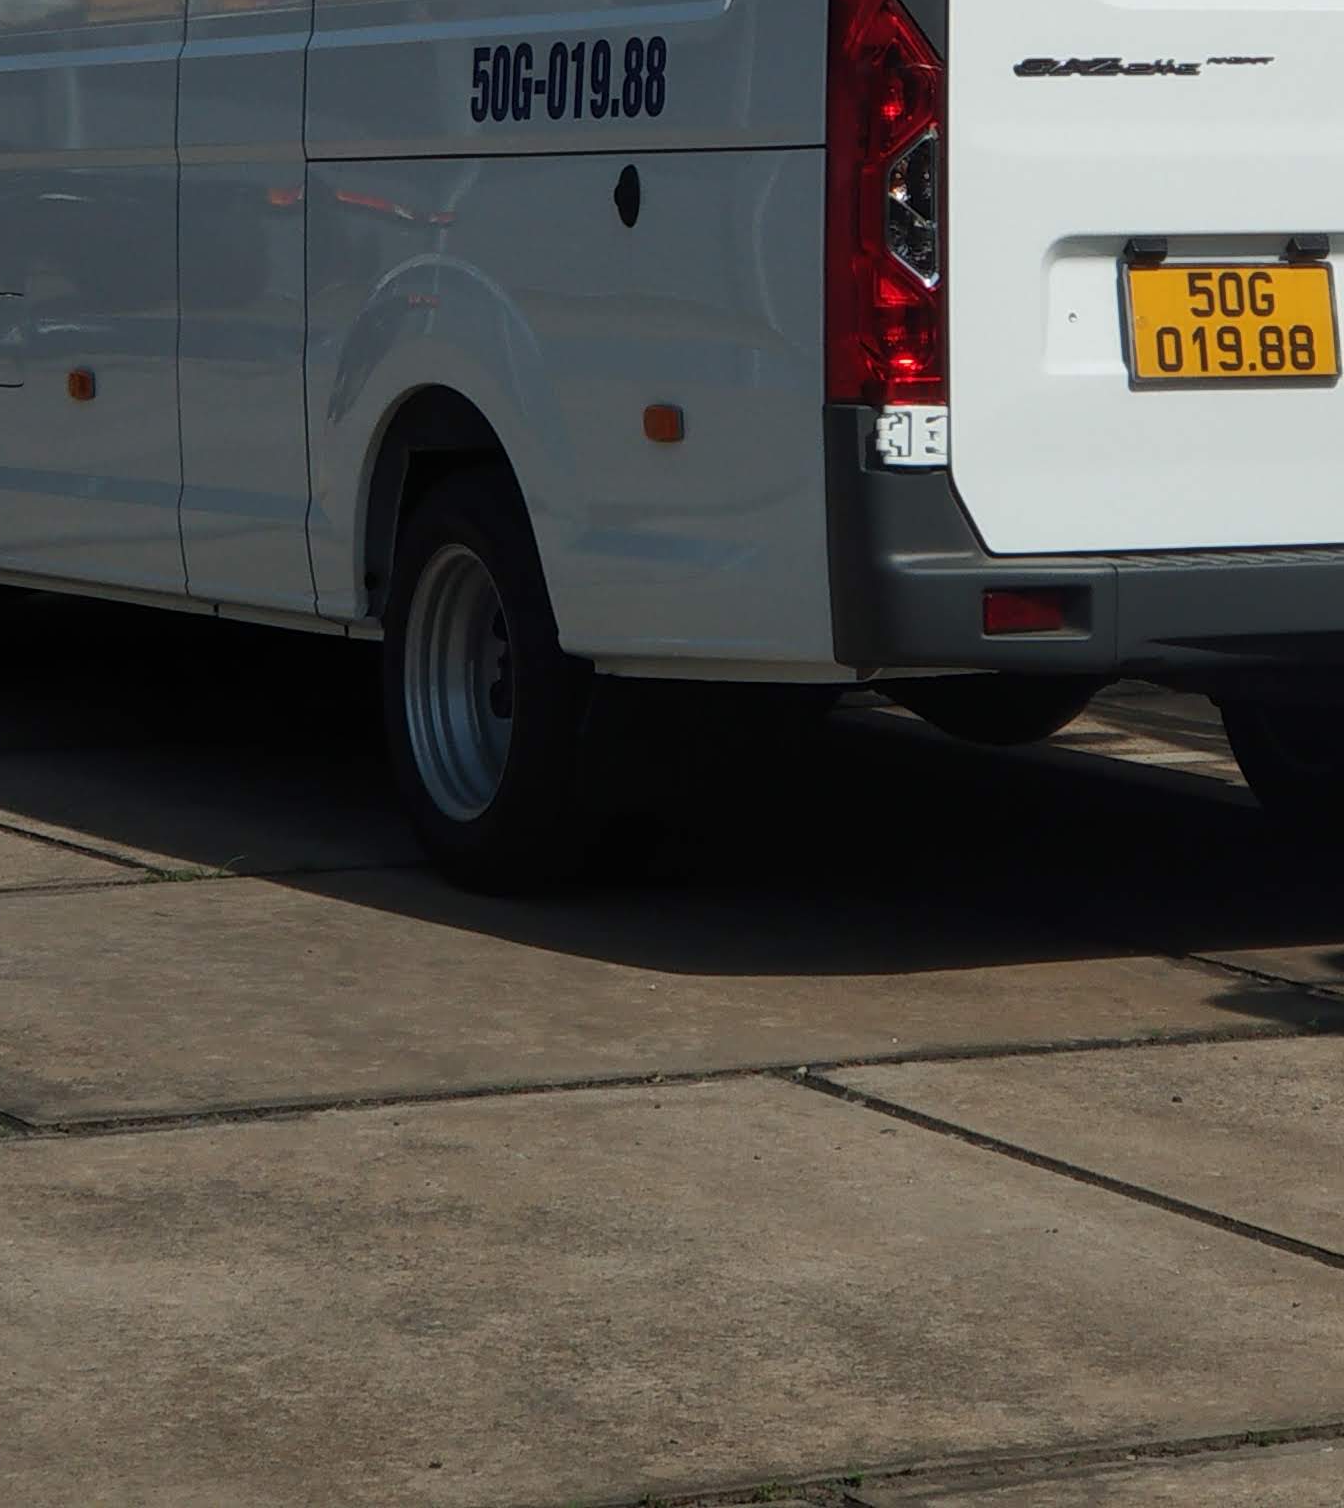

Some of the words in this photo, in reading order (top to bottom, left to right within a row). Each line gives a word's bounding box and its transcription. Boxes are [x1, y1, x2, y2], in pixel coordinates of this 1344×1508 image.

[470, 35, 667, 123] 50G-019.88
[1187, 271, 1275, 318] 50G
[1155, 324, 1316, 373] 019.88
